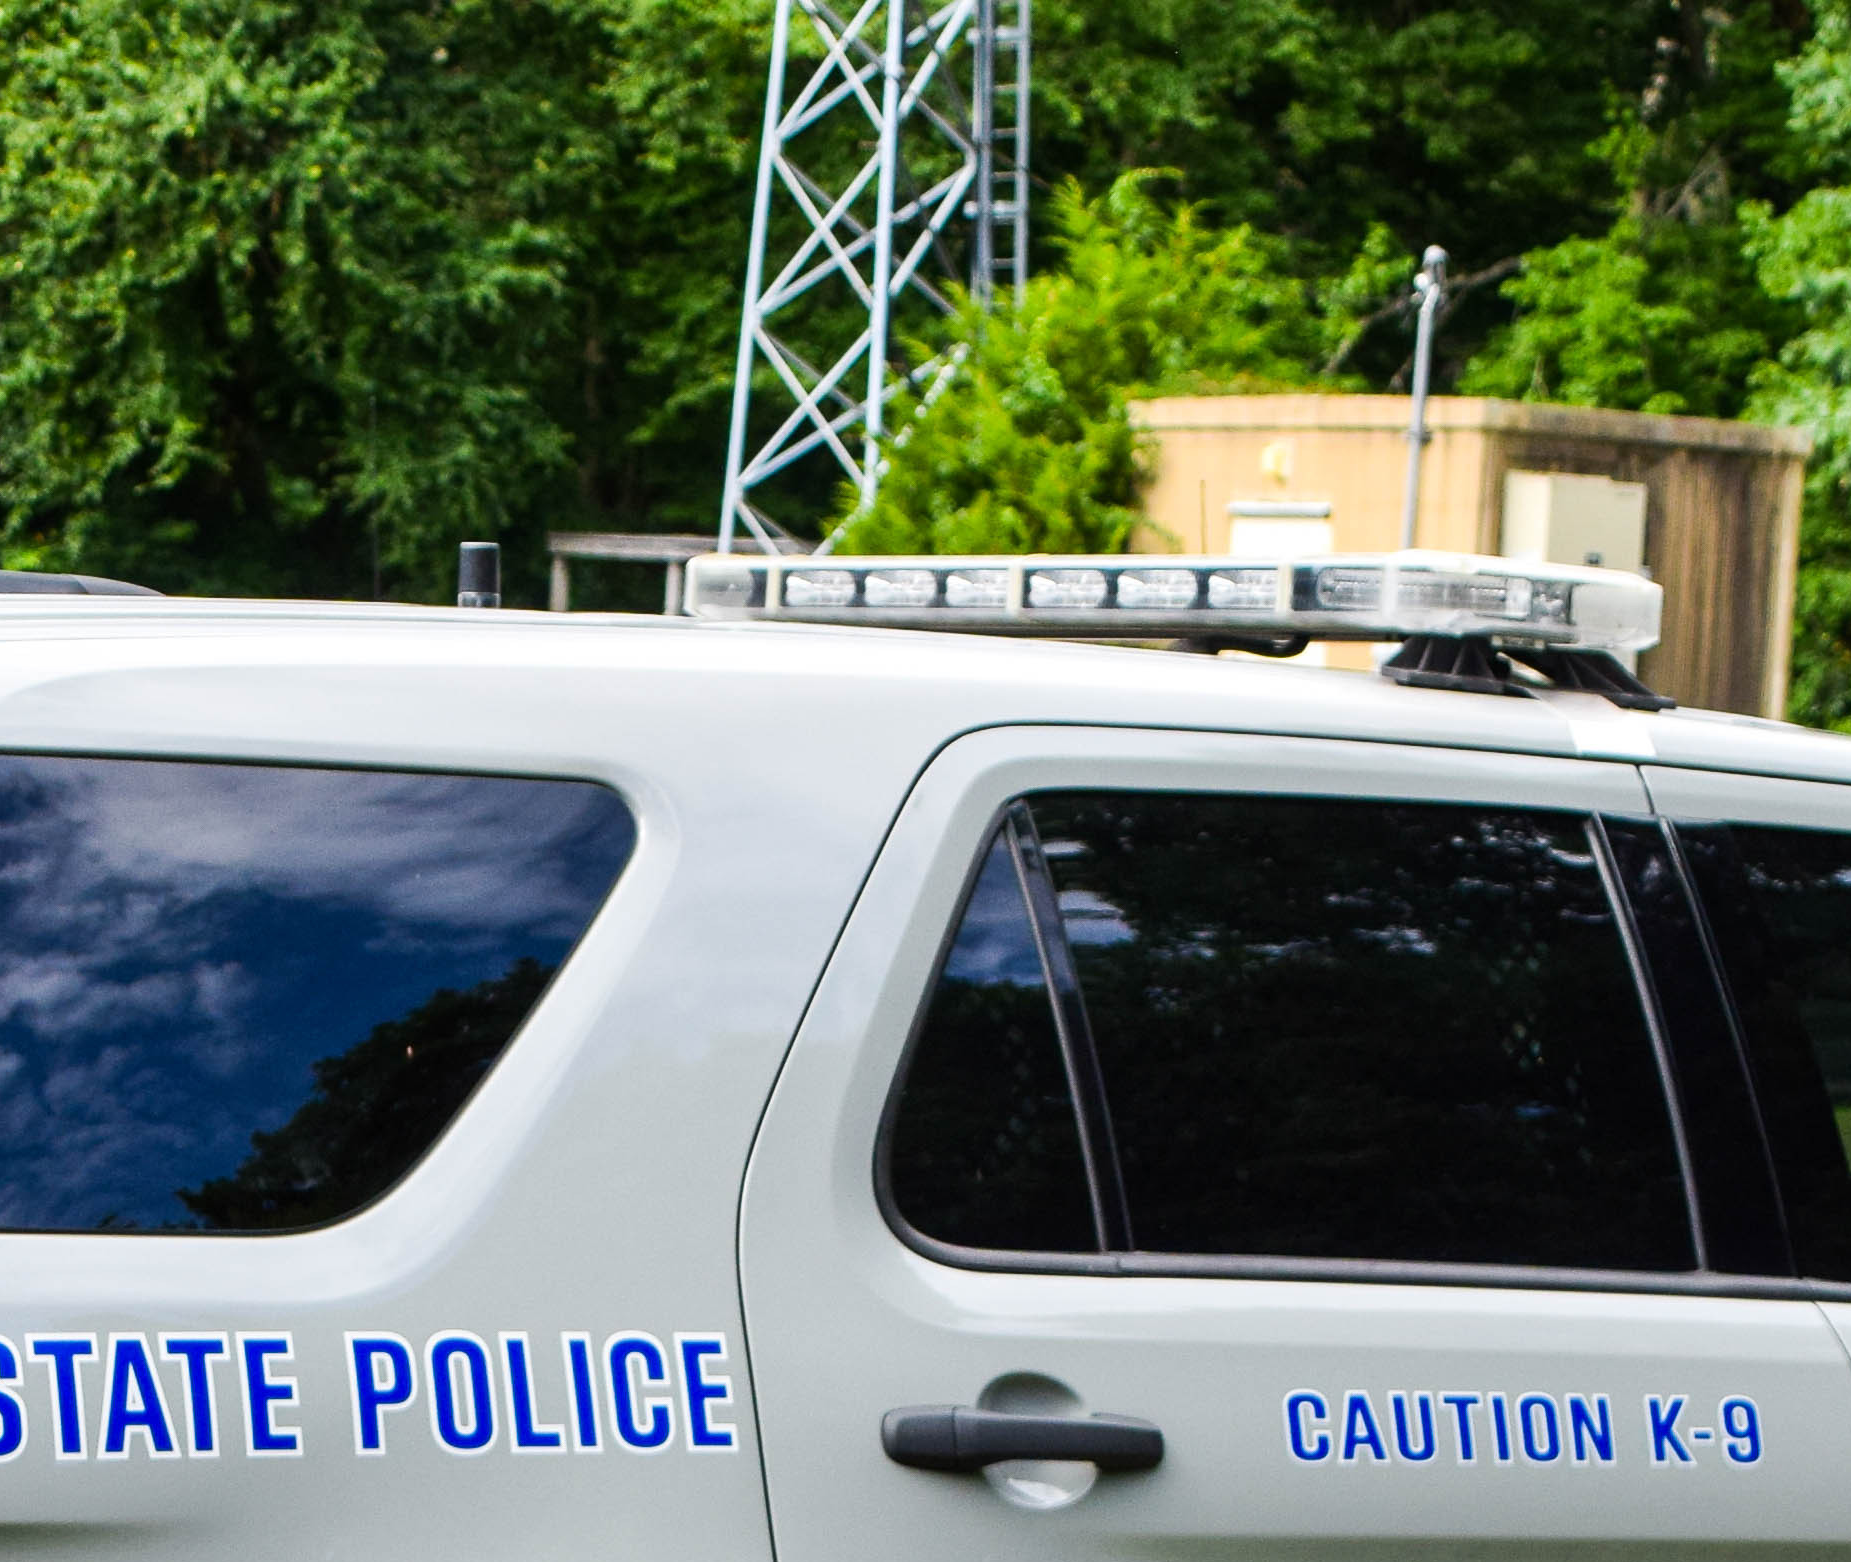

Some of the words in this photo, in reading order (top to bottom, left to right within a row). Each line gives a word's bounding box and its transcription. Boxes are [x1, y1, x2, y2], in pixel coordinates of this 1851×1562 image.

[344, 1331, 739, 1457] POLICE
[1282, 1389, 1617, 1467] CAUTION
[1643, 1394, 1765, 1467] K-9
